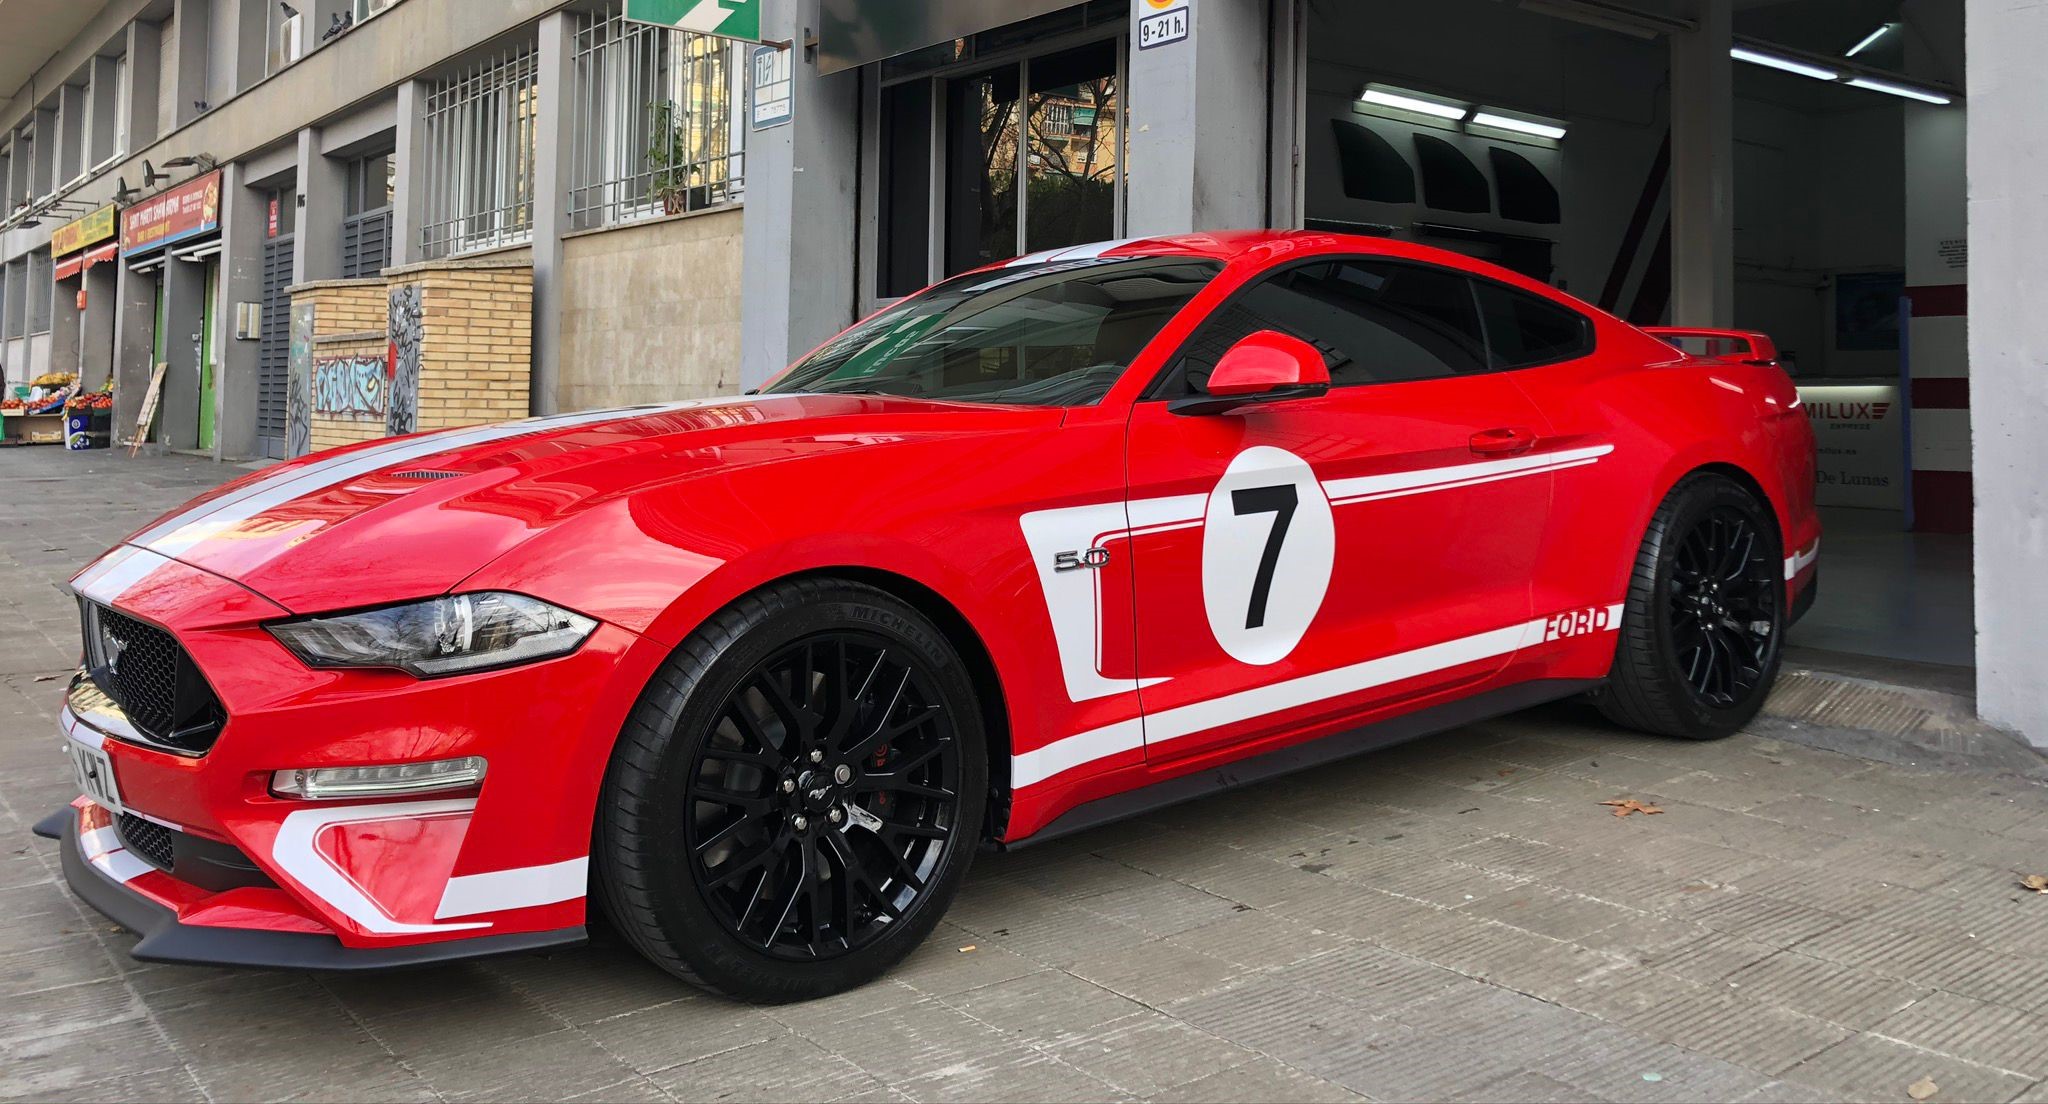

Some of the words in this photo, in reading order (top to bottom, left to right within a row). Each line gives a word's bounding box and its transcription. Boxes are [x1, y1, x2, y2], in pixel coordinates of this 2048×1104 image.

[1174, 16, 1184, 34] h.
[1840, 471, 1889, 487] Lunas
[1054, 547, 1109, 572] 5.0
[1230, 483, 1299, 629] 7
[848, 605, 948, 669] MICHELIN
[1544, 605, 1609, 641] FORD
